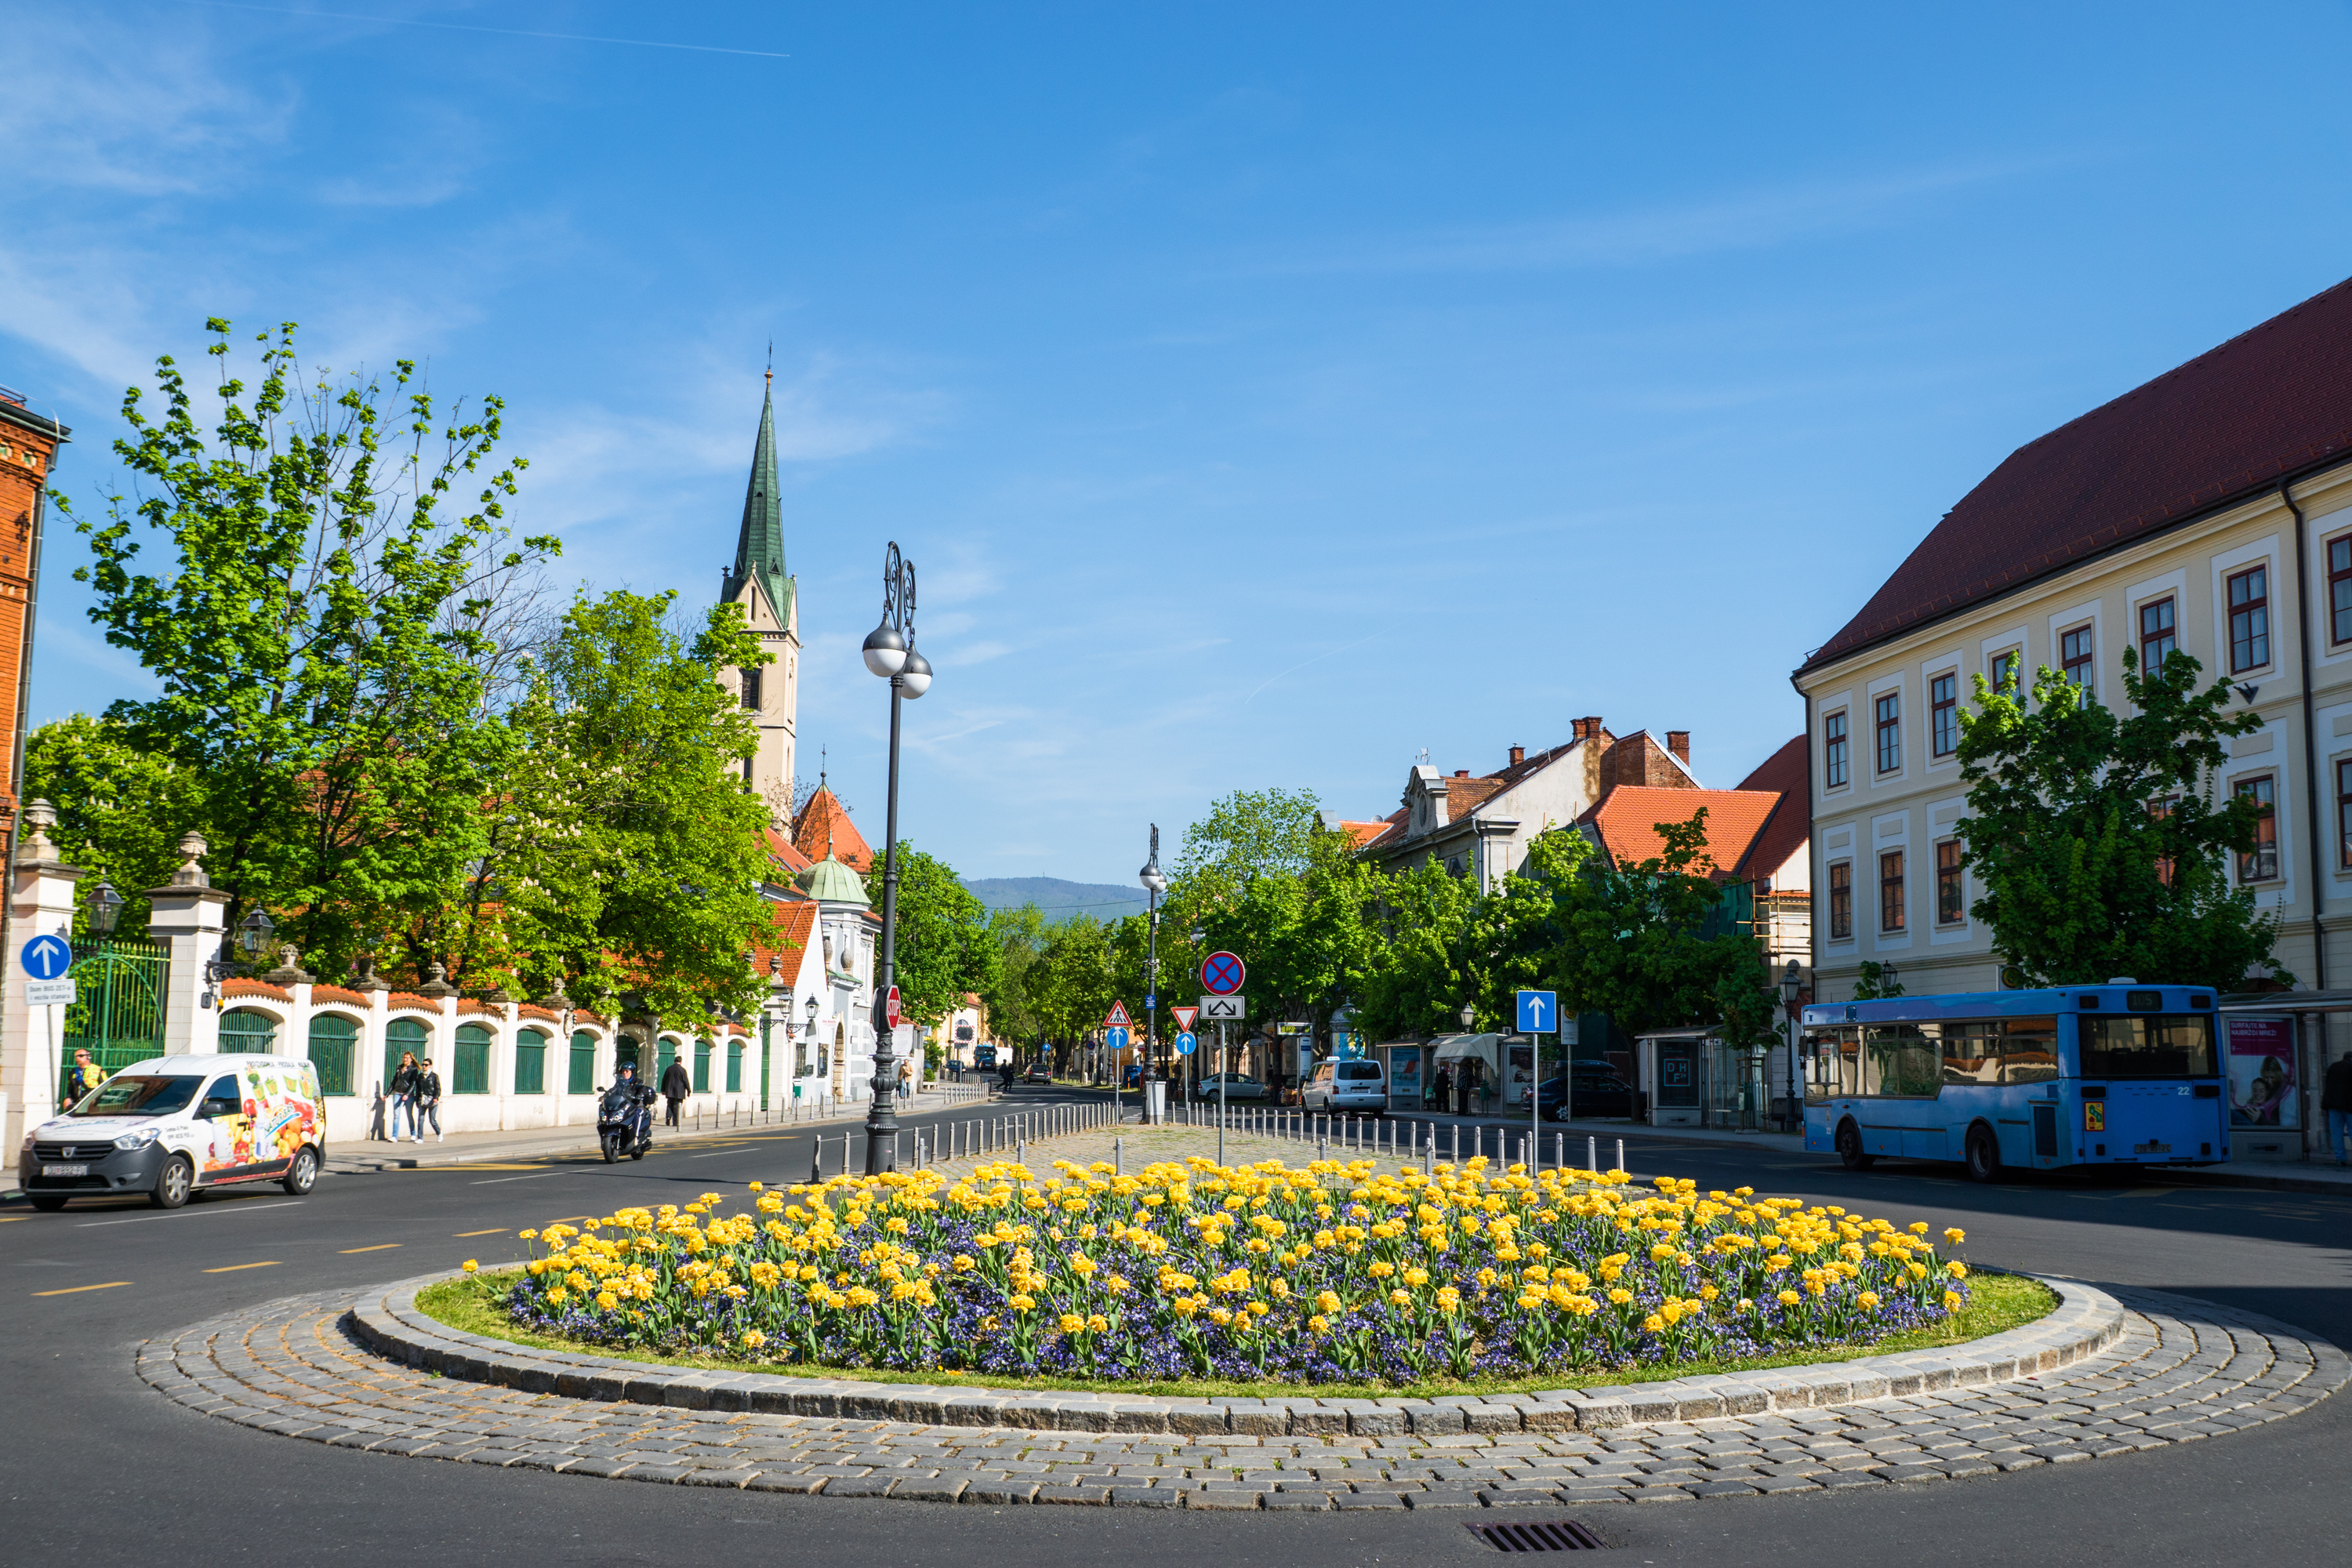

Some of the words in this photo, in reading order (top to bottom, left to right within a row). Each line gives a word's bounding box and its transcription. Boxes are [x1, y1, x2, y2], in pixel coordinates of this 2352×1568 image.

[888, 999, 899, 1016] STOP
[1668, 1062, 1675, 1073] D
[1679, 1062, 1686, 1073] H
[2178, 1087, 2190, 1095] 22
